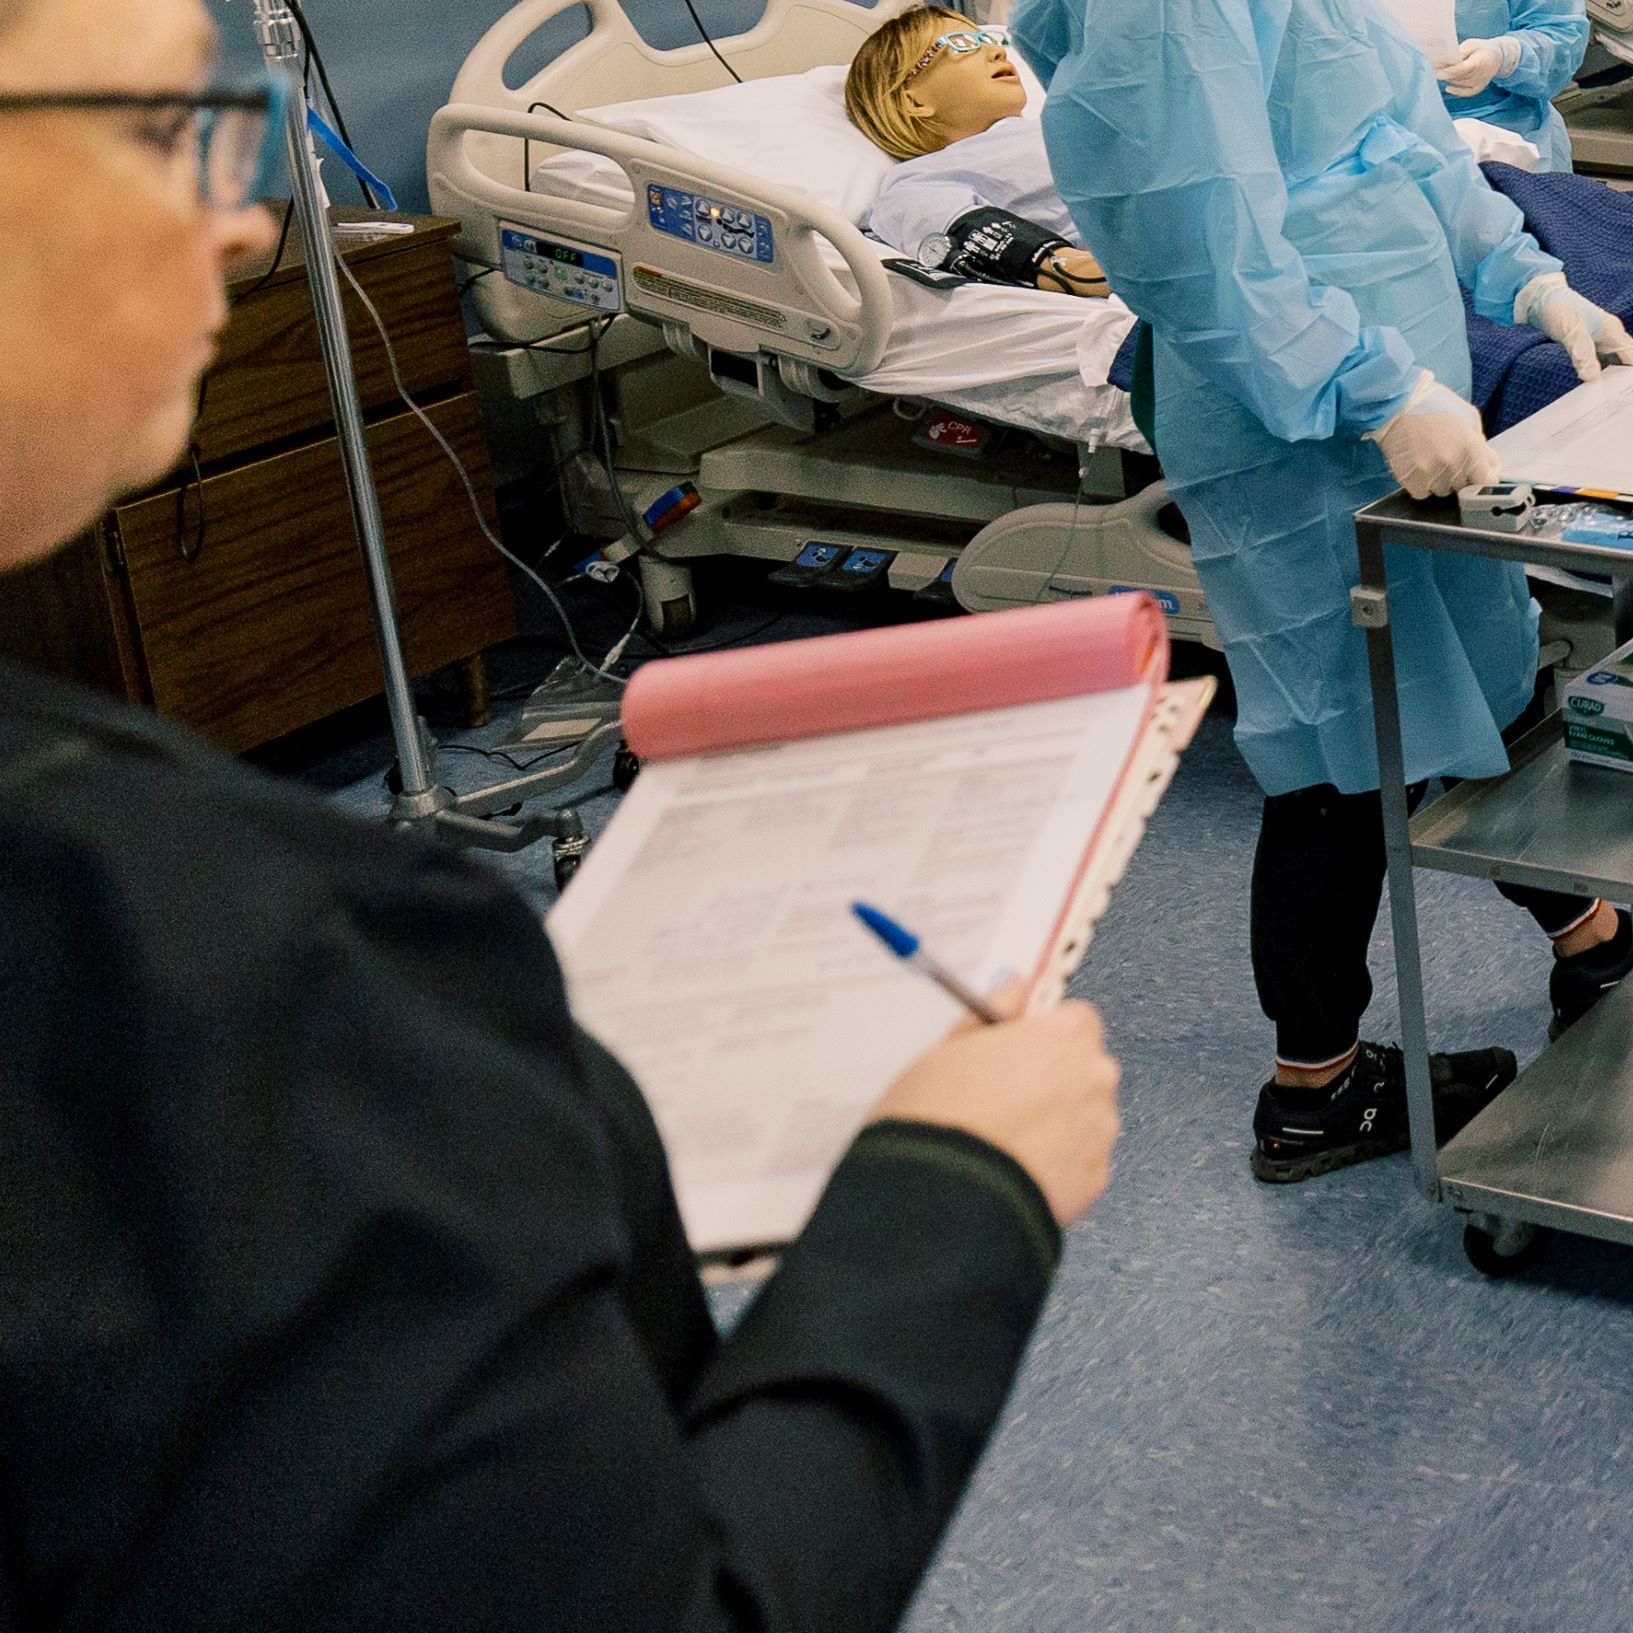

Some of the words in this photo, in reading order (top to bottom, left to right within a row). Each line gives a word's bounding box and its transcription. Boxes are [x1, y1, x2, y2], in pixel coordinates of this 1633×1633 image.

[555, 248, 577, 262] OFF
[948, 421, 972, 435] CPR
[1569, 697, 1604, 712] CURAD
[1587, 733, 1616, 746] GLOVES
